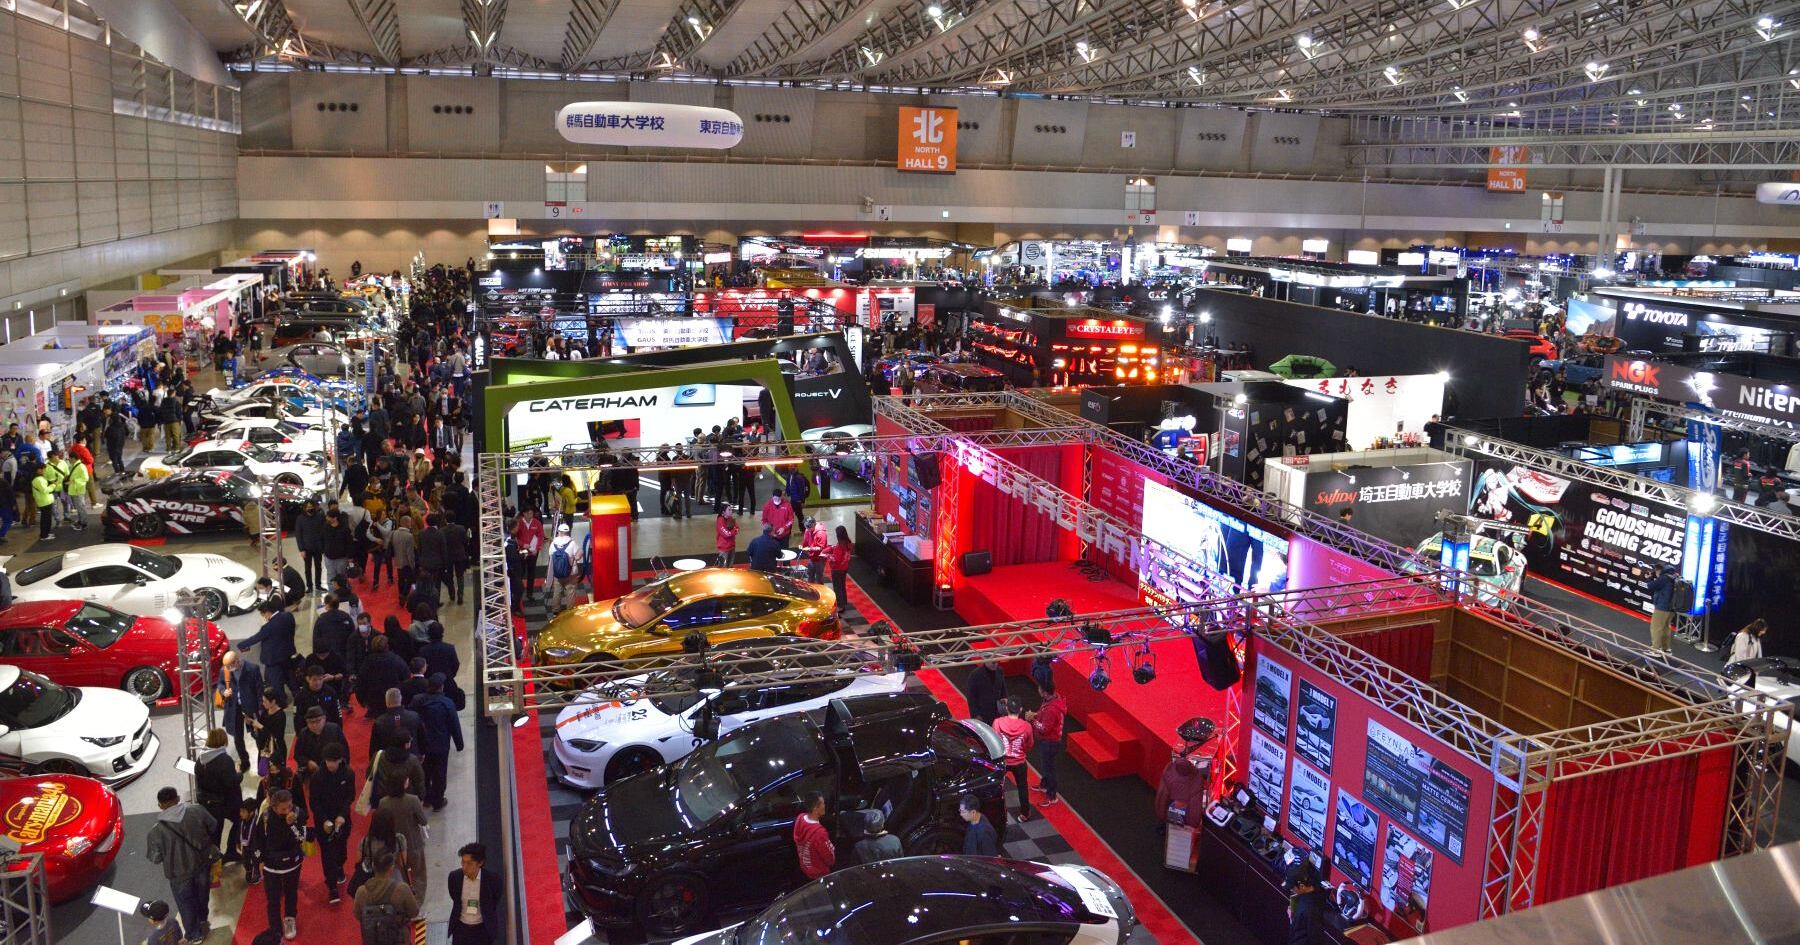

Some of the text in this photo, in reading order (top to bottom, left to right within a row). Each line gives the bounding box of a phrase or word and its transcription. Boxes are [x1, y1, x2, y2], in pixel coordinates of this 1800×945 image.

[566, 113, 665, 131] 群馬自動車大学校
[912, 110, 944, 144] 北
[914, 146, 940, 154] NORTH
[905, 155, 948, 170] HALL 9
[1489, 177, 1524, 190] HALL 10
[552, 207, 560, 218] 9
[1644, 309, 1688, 327] TOYOTA
[1076, 324, 1135, 335] CRYSTALEYE
[1611, 360, 1661, 386] NGK
[829, 388, 842, 399] V
[1611, 380, 1659, 395] SPARK PLUGS
[529, 394, 658, 413] CATERHAM
[1358, 479, 1462, 504] 埼玉自動車大学校
[169, 512, 208, 524] TIRE
[1595, 508, 1685, 548] GOODSMILE
[1584, 521, 1683, 566] RACING 2023
